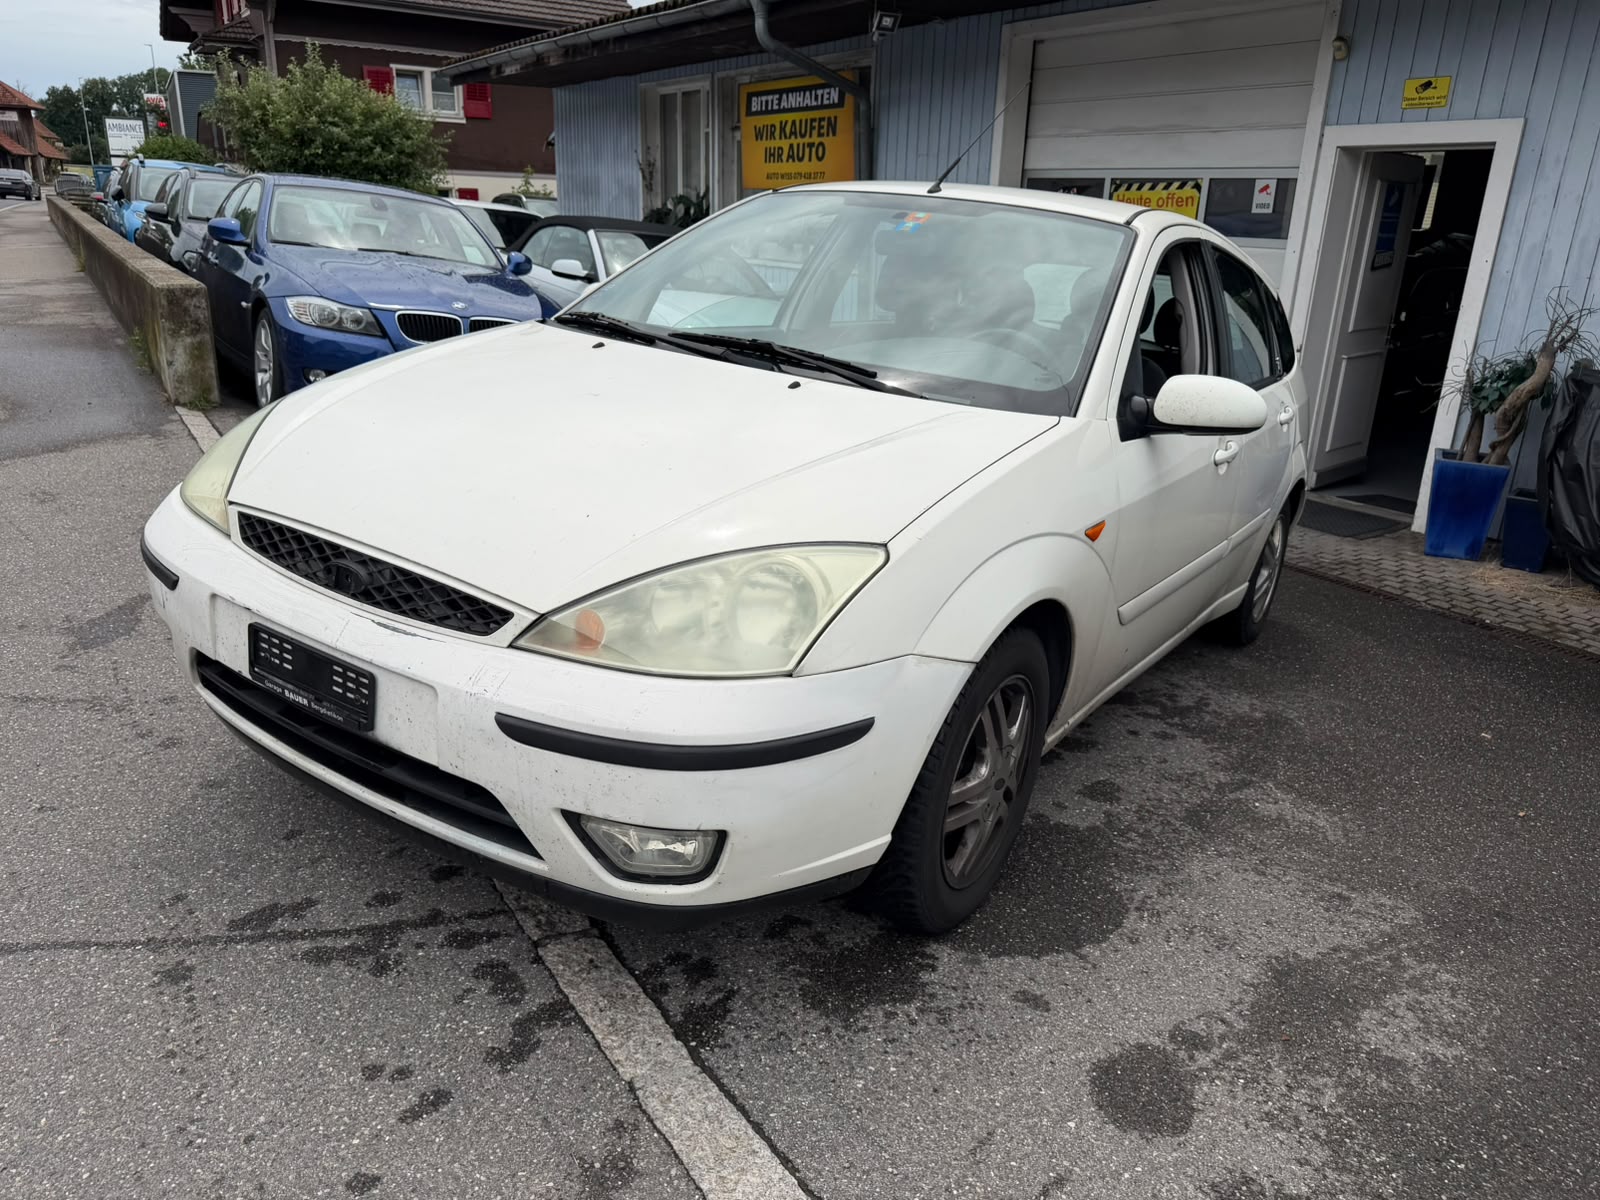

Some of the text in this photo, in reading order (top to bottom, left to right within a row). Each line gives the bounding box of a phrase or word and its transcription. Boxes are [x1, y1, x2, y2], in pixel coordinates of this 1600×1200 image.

[146, 96, 163, 104] AVIA
[751, 87, 839, 112] BITTE ANHALTEN
[107, 122, 143, 133] AMBIANCE
[754, 116, 838, 142] WIR KAUFEN
[764, 141, 826, 164] IHR AUTO
[1156, 192, 1195, 208] offen
[284, 689, 309, 707] BAUER
